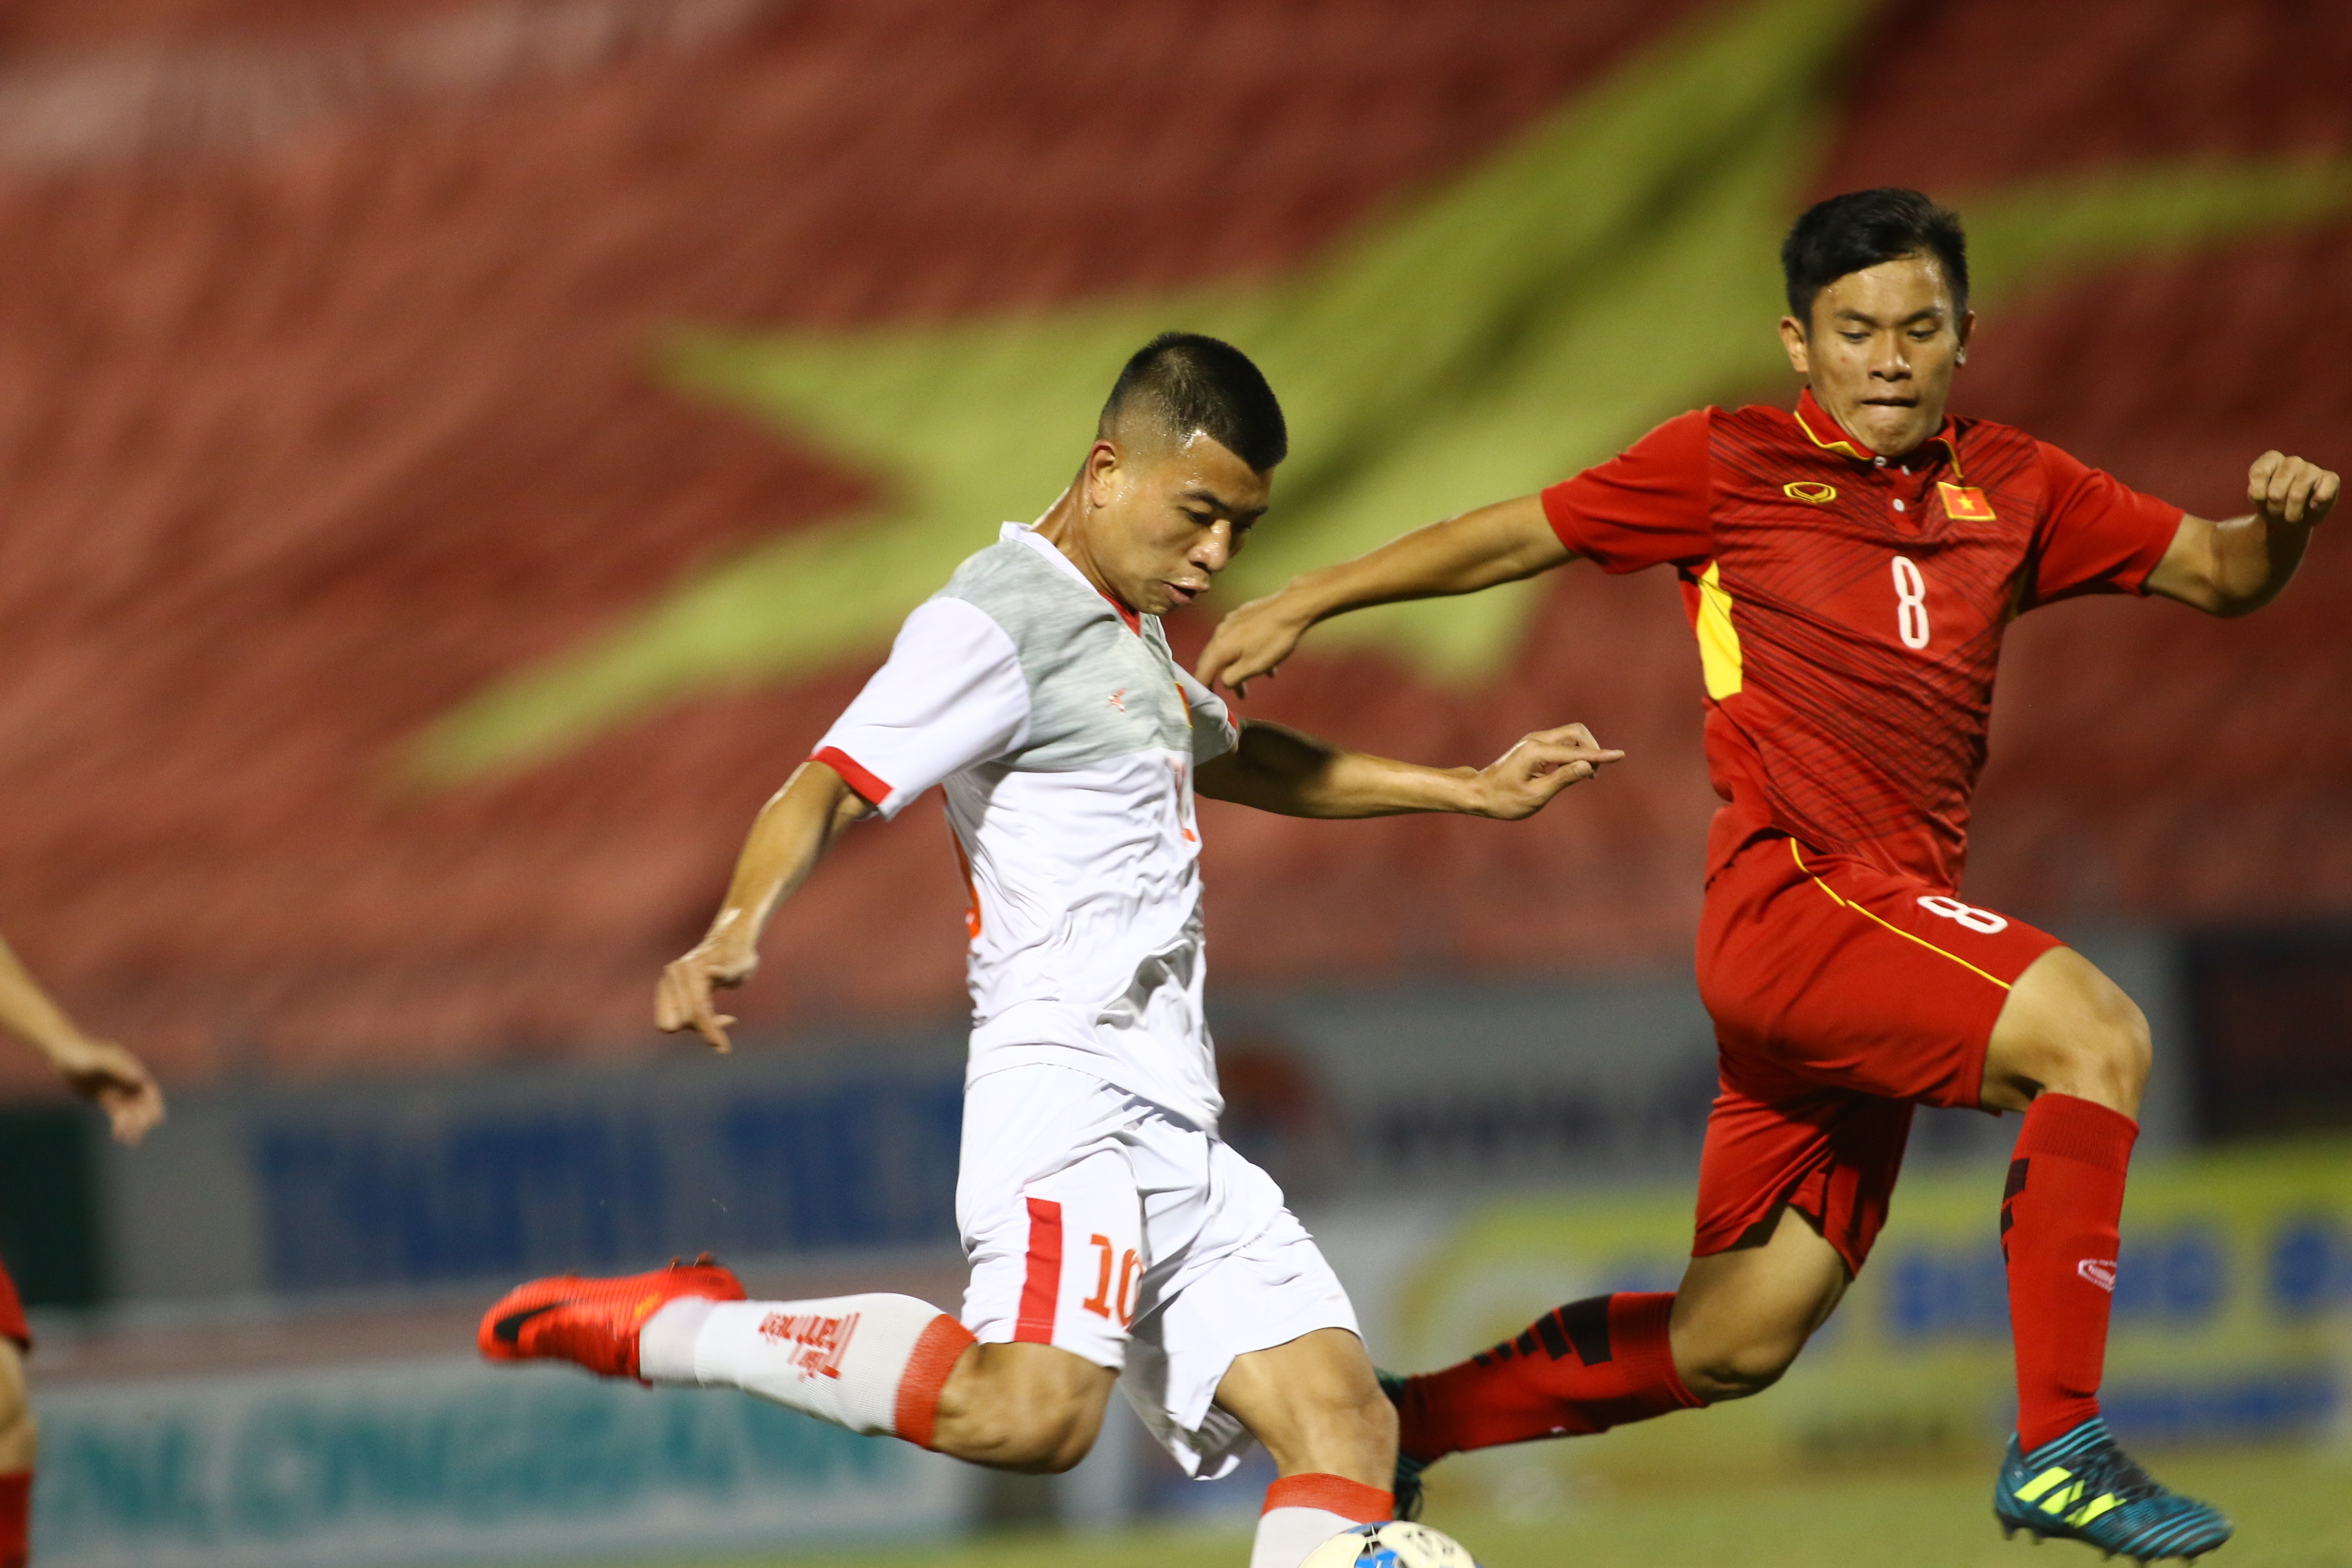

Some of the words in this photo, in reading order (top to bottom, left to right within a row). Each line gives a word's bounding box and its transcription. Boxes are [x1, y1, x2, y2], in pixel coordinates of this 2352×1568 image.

[1891, 555, 1930, 650] 8
[1917, 896, 2008, 934] 8
[1082, 1233, 1144, 1333] 10
